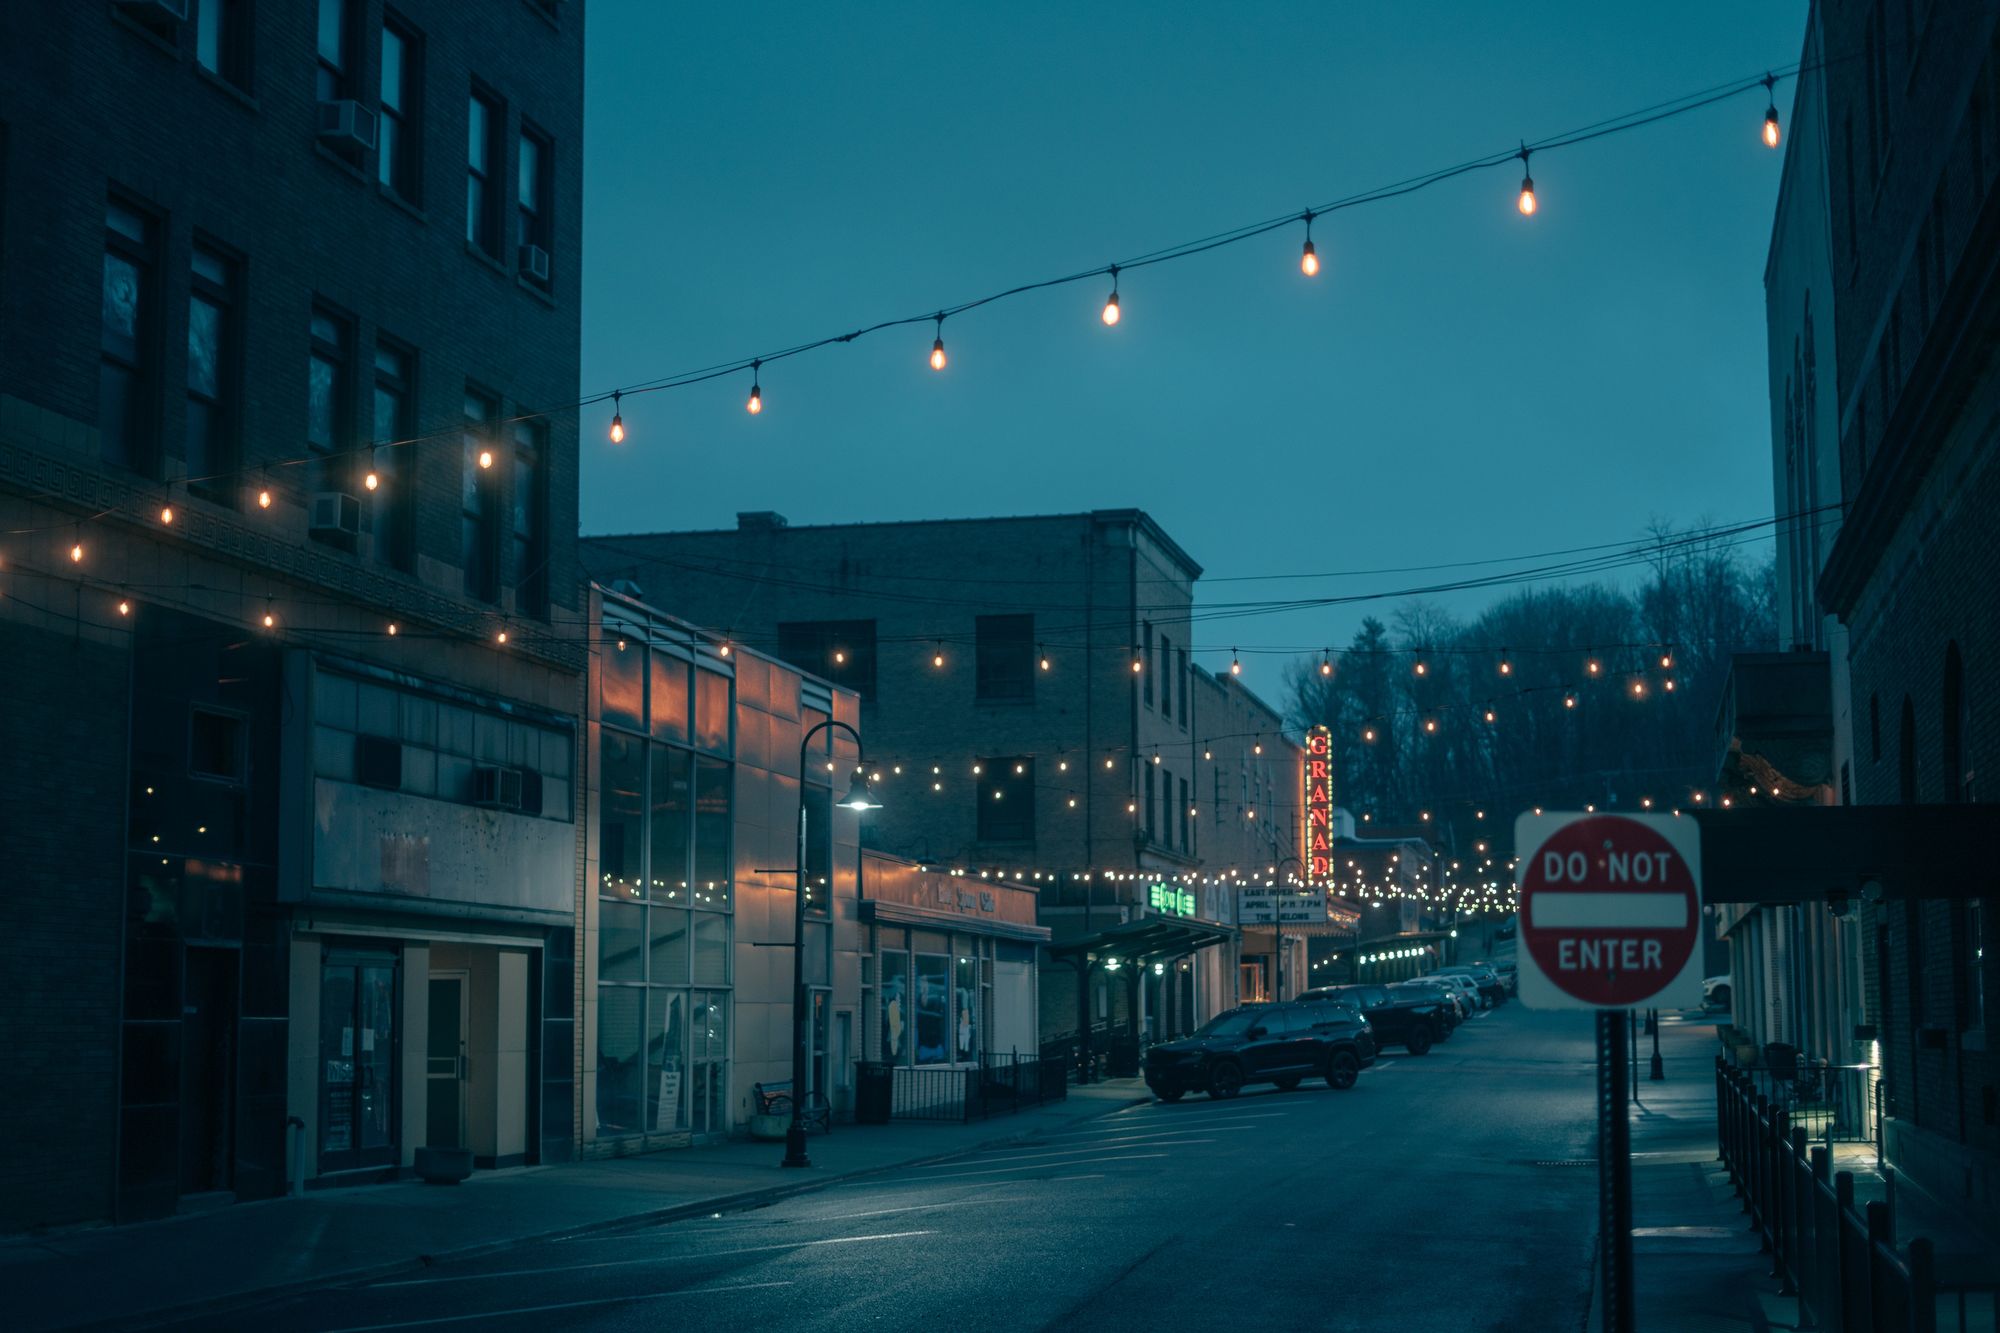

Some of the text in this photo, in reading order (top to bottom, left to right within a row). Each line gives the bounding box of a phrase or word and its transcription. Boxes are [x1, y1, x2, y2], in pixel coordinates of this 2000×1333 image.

[1543, 851, 1671, 883] DO NOT
[1245, 901, 1271, 909] APRIL
[1256, 913, 1272, 921] THE
[1558, 938, 1663, 970] ENTER
